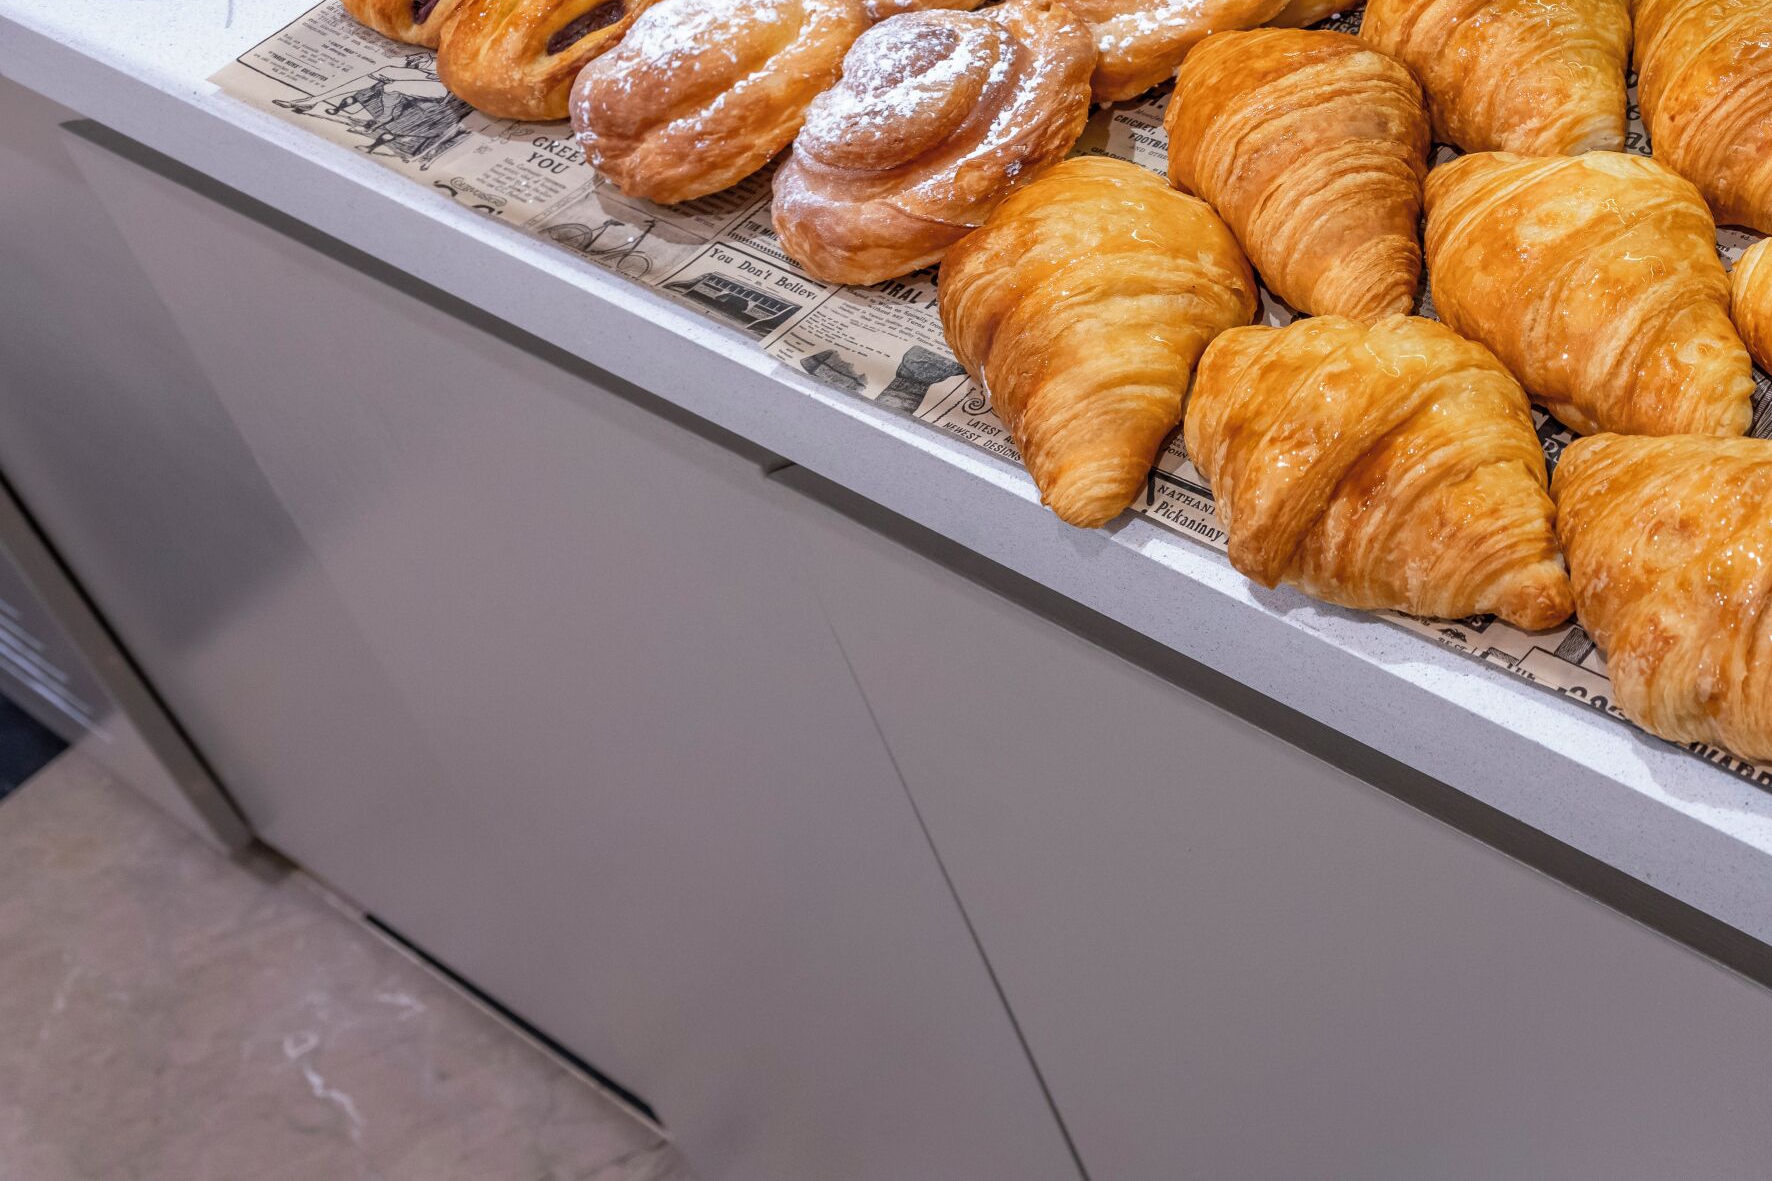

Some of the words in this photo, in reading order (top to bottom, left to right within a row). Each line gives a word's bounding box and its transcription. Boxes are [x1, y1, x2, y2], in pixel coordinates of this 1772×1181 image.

[1114, 114, 1157, 135] CRICKET,
[525, 151, 571, 175] YOU
[708, 247, 736, 266] You
[736, 260, 773, 282] Don't
[942, 421, 982, 442] NEWEST
[965, 418, 1003, 437] LATEST
[1153, 499, 1226, 541] Pickaninny
